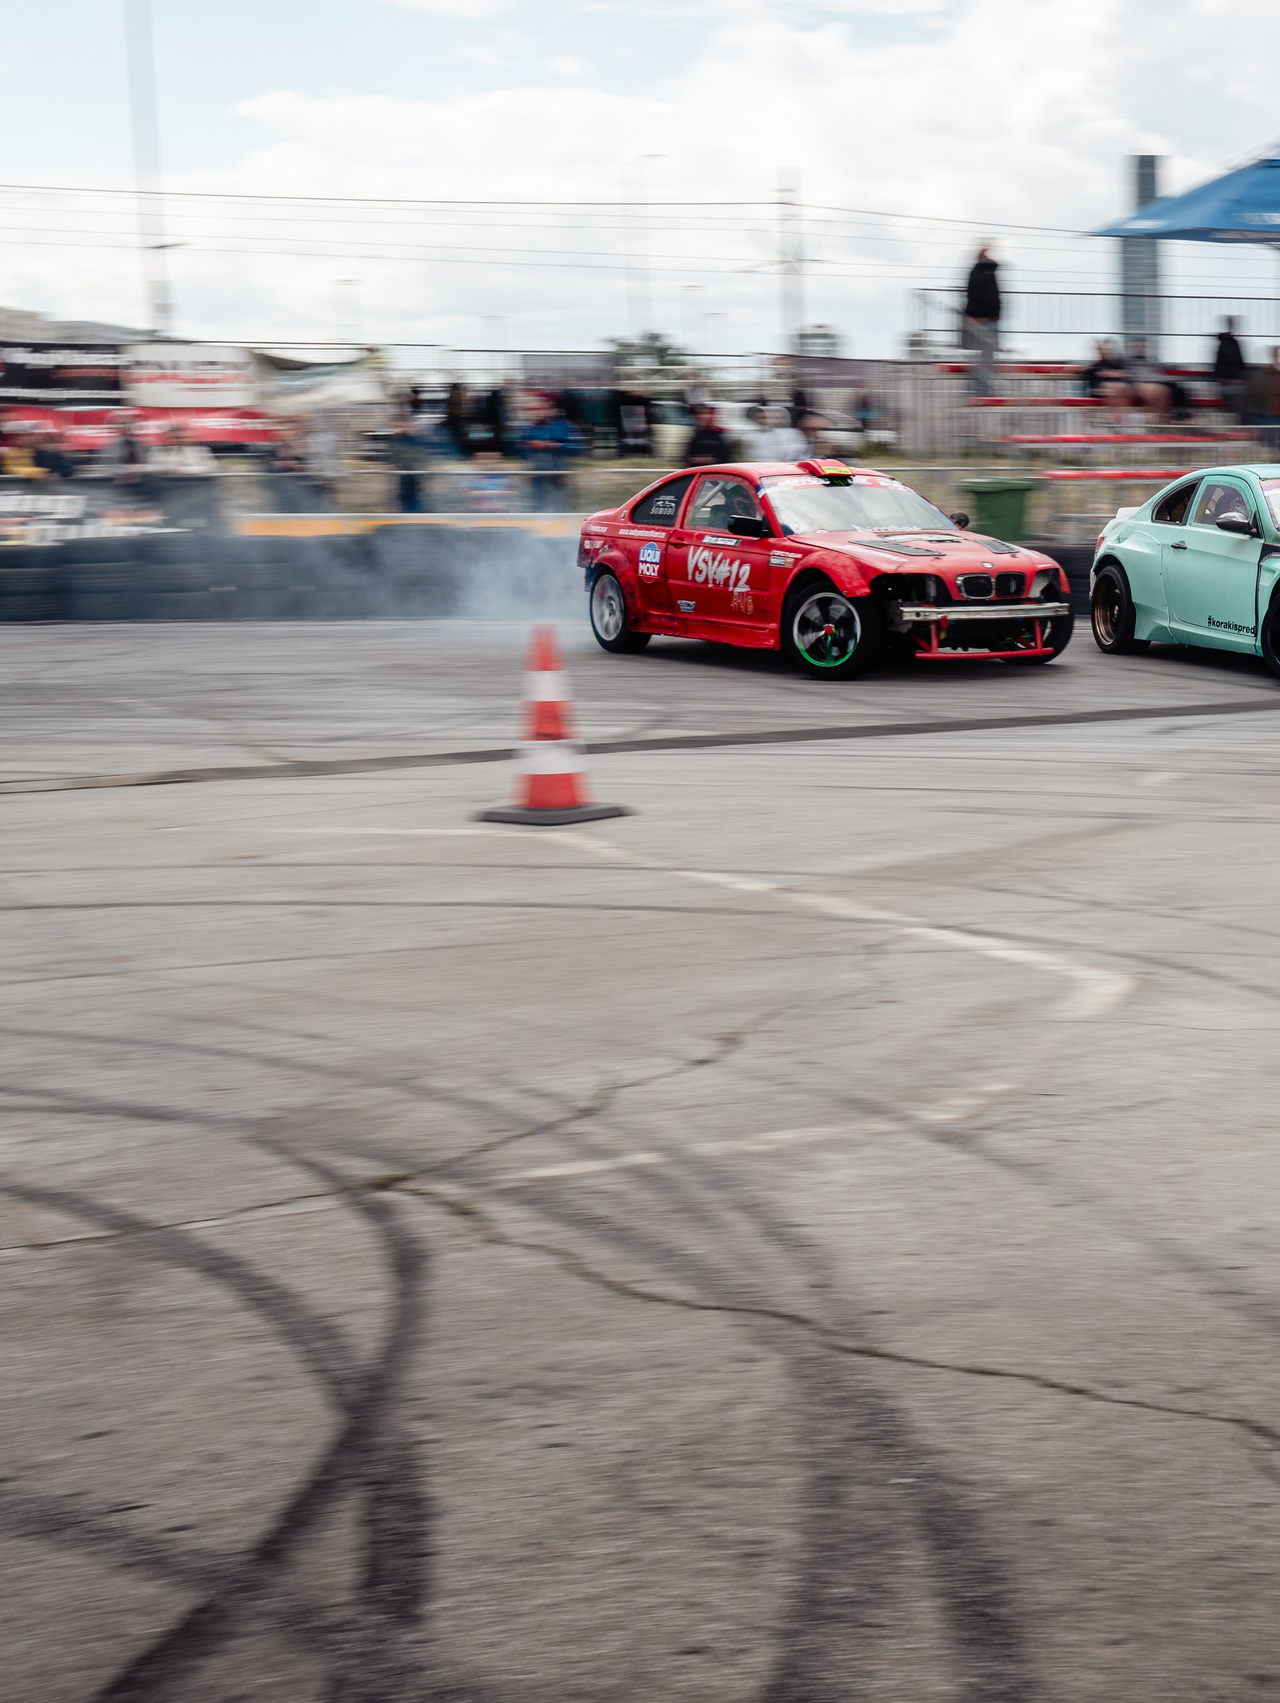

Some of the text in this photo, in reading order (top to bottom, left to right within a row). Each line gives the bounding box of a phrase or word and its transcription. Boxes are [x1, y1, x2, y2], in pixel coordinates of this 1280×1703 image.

[640, 548, 661, 562] LIQUI
[638, 563, 660, 577] MOLY
[687, 545, 751, 595] VSV#12
[1207, 615, 1256, 634] #korakispred
